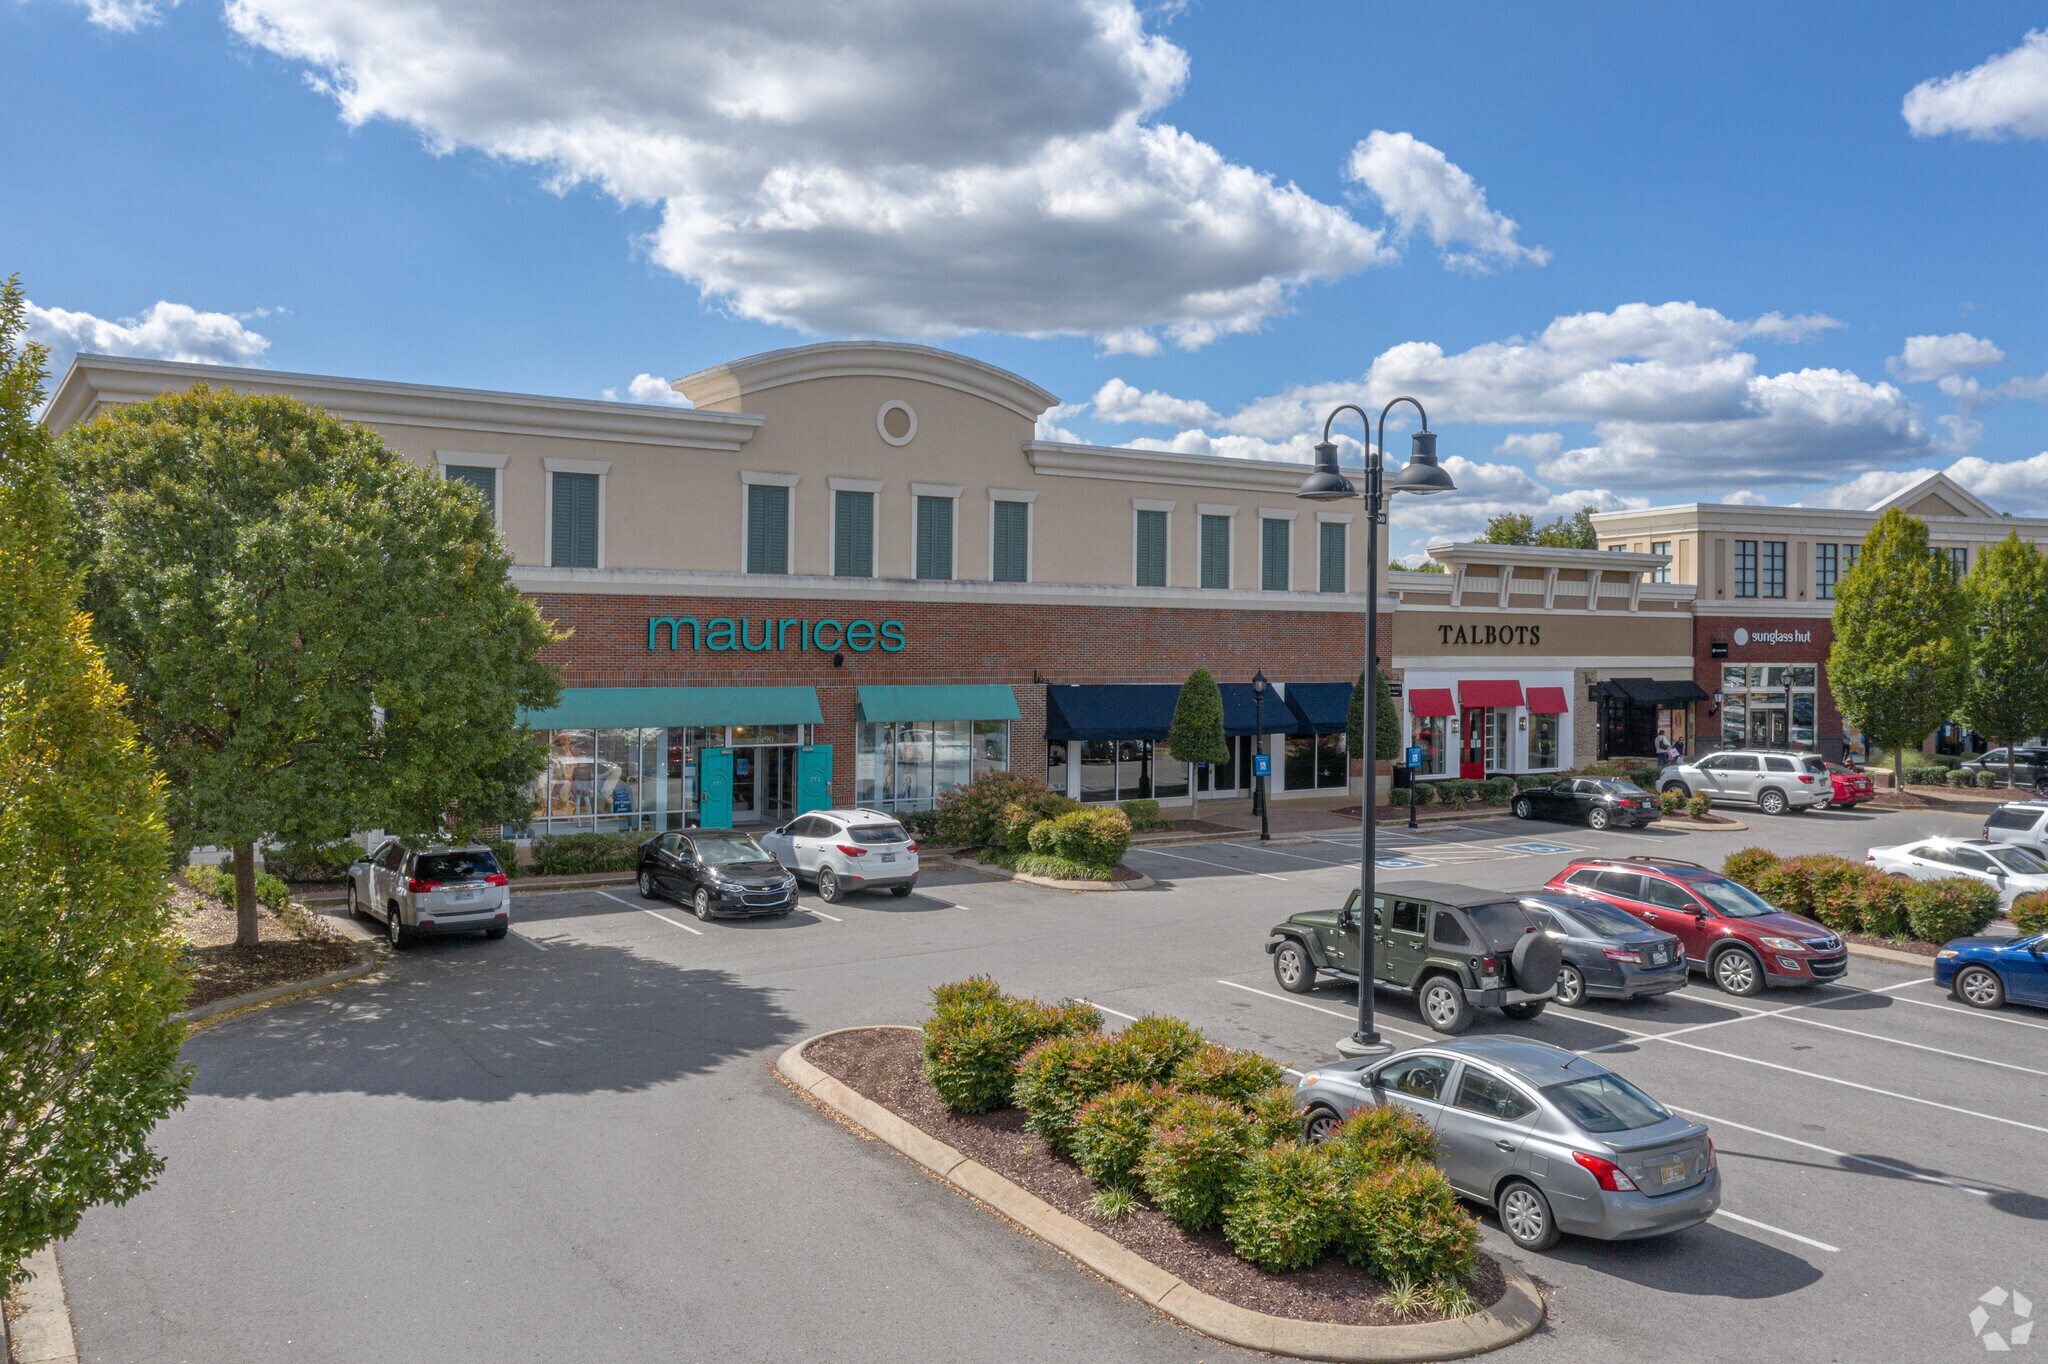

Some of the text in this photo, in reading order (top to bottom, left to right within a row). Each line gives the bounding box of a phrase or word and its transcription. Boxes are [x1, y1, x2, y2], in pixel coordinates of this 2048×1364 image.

[648, 616, 906, 652] maurices
[1438, 624, 1540, 645] TALBOTS
[1751, 629, 1812, 646] sunglass hut
